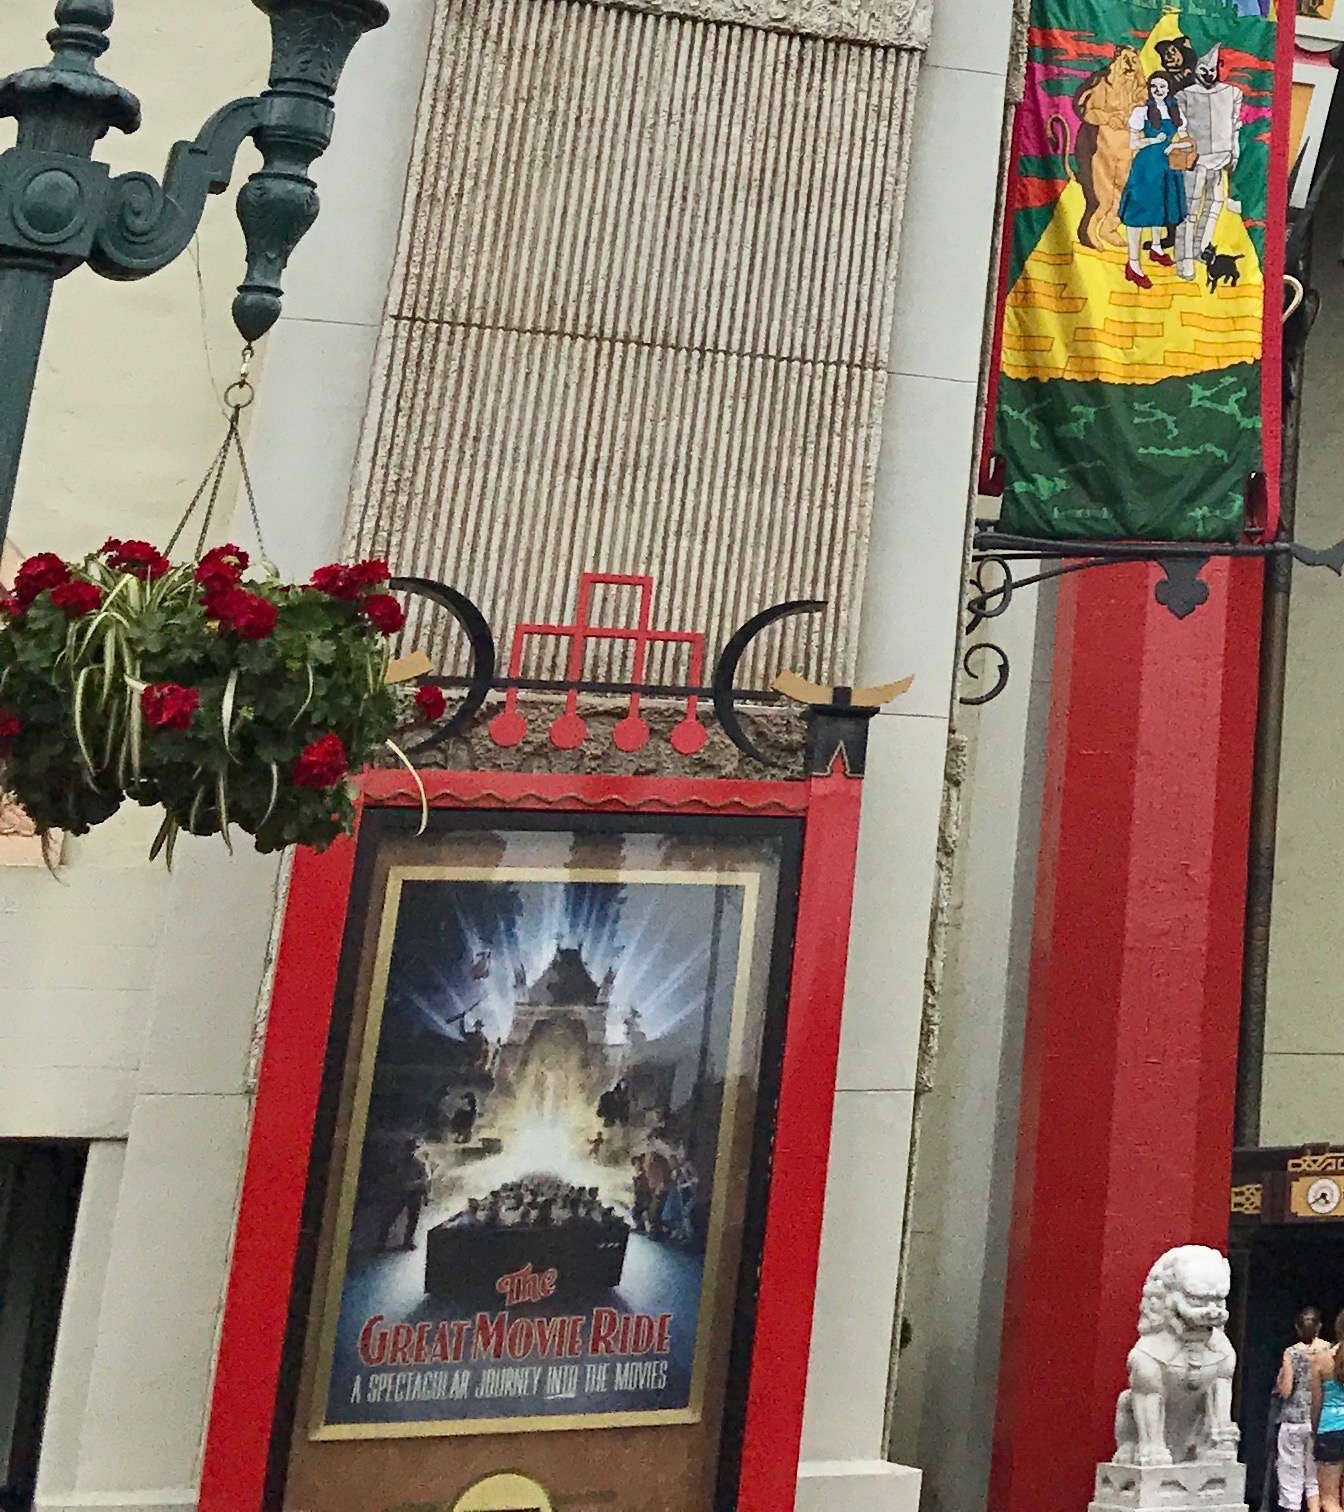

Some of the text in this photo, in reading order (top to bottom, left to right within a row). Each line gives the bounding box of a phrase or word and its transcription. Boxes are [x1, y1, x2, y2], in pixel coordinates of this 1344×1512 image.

[496, 1262, 558, 1305] The
[358, 1306, 672, 1367] GREAT MOVIE RIDE
[351, 1360, 669, 1403] A SPECTACULAR JOURNEY INTO THE MOVIES
